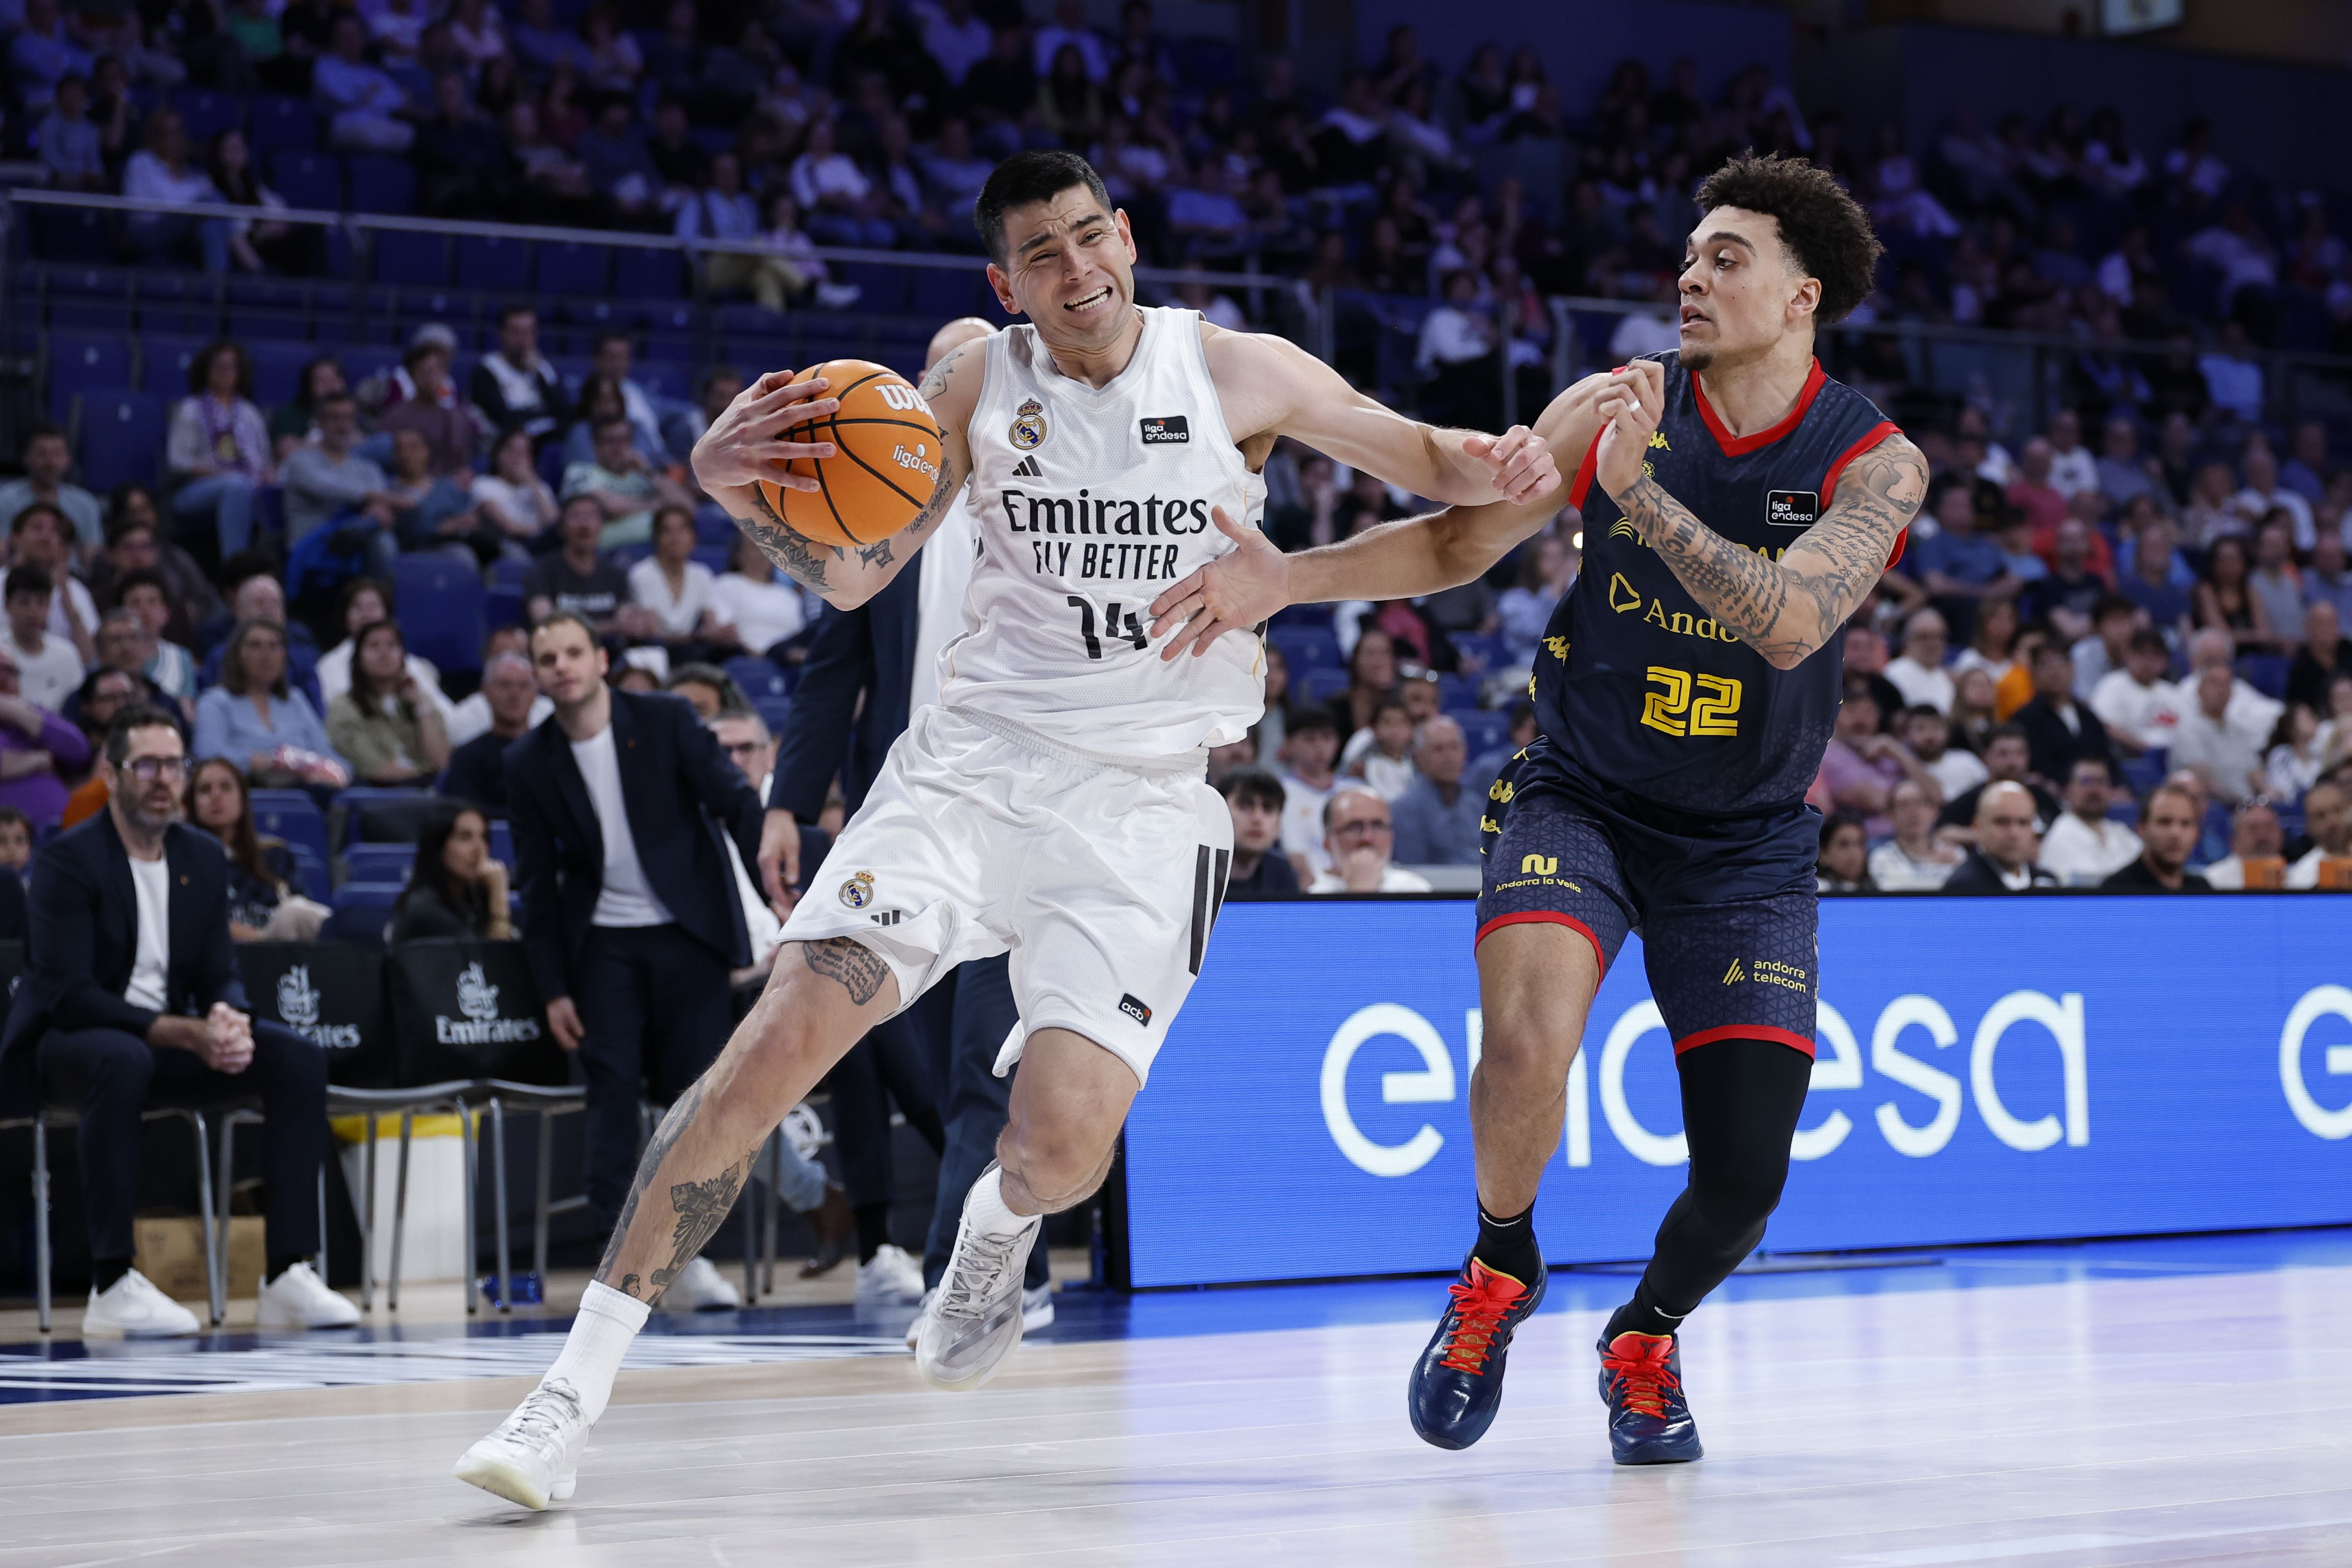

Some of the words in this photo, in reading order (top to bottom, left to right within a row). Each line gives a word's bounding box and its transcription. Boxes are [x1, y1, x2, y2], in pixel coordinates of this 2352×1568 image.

[874, 385, 936, 421] Wil
[1144, 424, 1164, 433] liga
[1146, 431, 1187, 440] endesa
[893, 444, 921, 470] liga
[1002, 488, 1208, 535] Emirates
[1771, 511, 1813, 521] endesa
[1772, 501, 1791, 512] liga
[1033, 541, 1072, 577] FLY
[1081, 543, 1179, 580] BETTER
[1067, 595, 1148, 659] 14
[1643, 598, 1740, 643] Ando
[1640, 666, 1742, 736] 22
[1495, 879, 1540, 893] Andorra
[1543, 876, 1554, 885] la
[1556, 878, 1581, 893] Vella
[1753, 971, 1806, 993] telecom
[1754, 960, 1805, 979] andorra
[436, 1014, 540, 1044] Emirates
